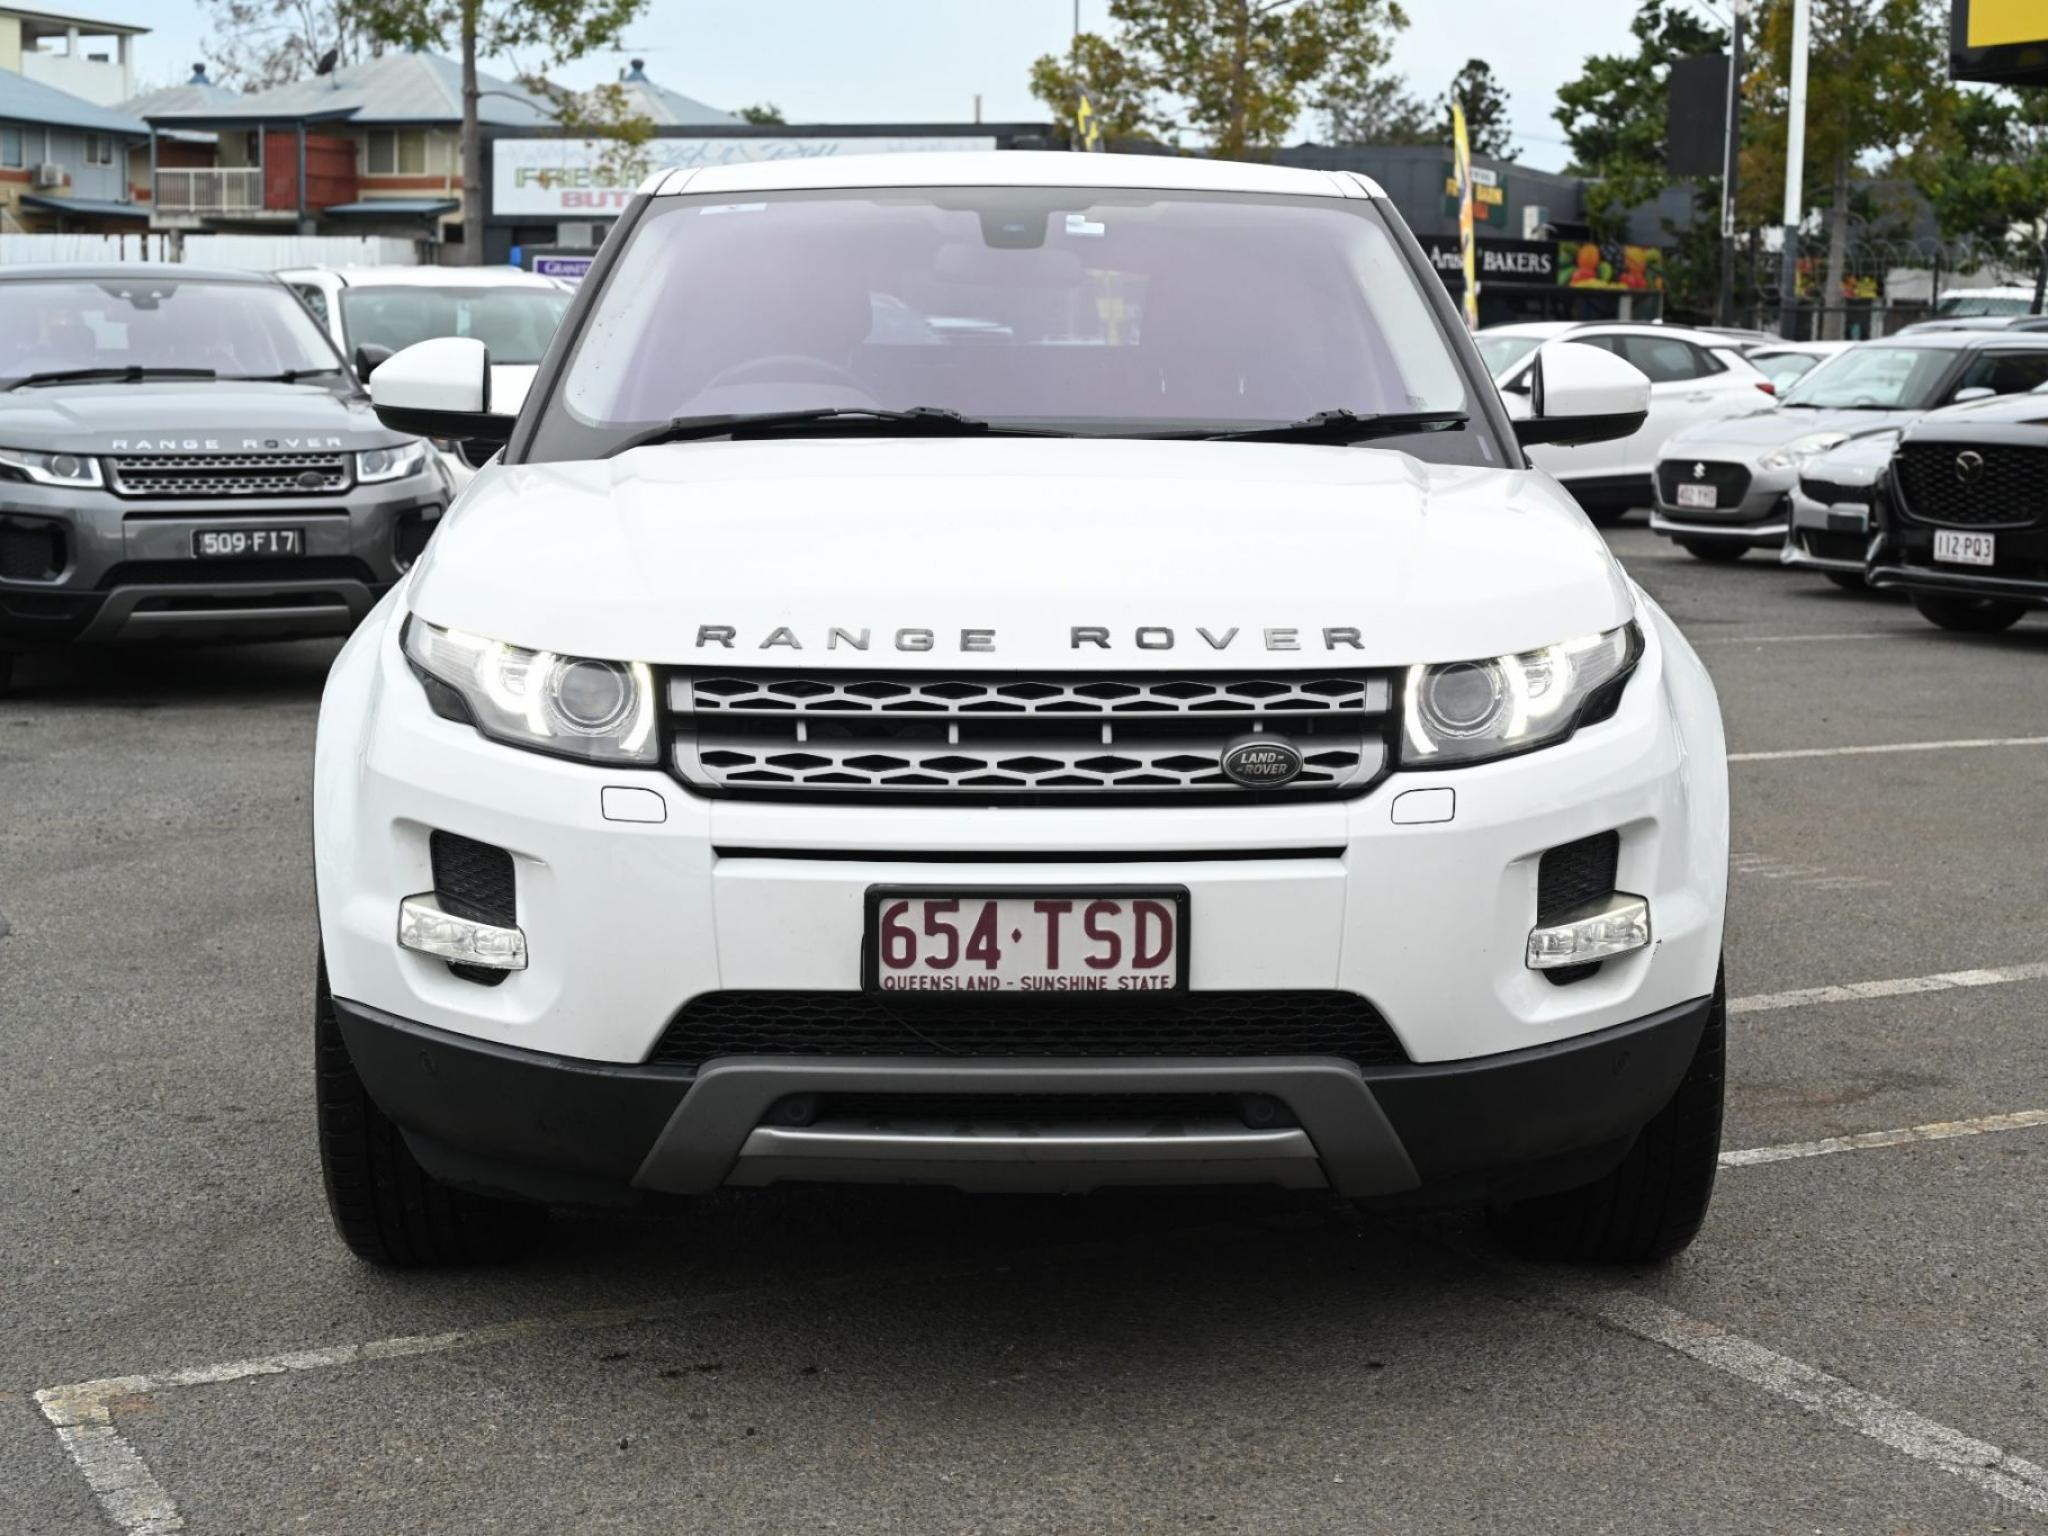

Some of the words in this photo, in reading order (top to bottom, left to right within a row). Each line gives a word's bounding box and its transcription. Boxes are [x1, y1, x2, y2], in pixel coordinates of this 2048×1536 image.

[562, 191, 629, 208] BUT
[1483, 250, 1552, 274] BAKERS
[112, 438, 219, 450] RANGE
[242, 436, 342, 449] ROVER
[695, 624, 996, 652] RANGE
[1070, 625, 1365, 652] ROVER
[884, 975, 1000, 991] QUEENSLAND
[1020, 975, 1108, 991] SUNSHINE
[1118, 975, 1171, 991] STATE
